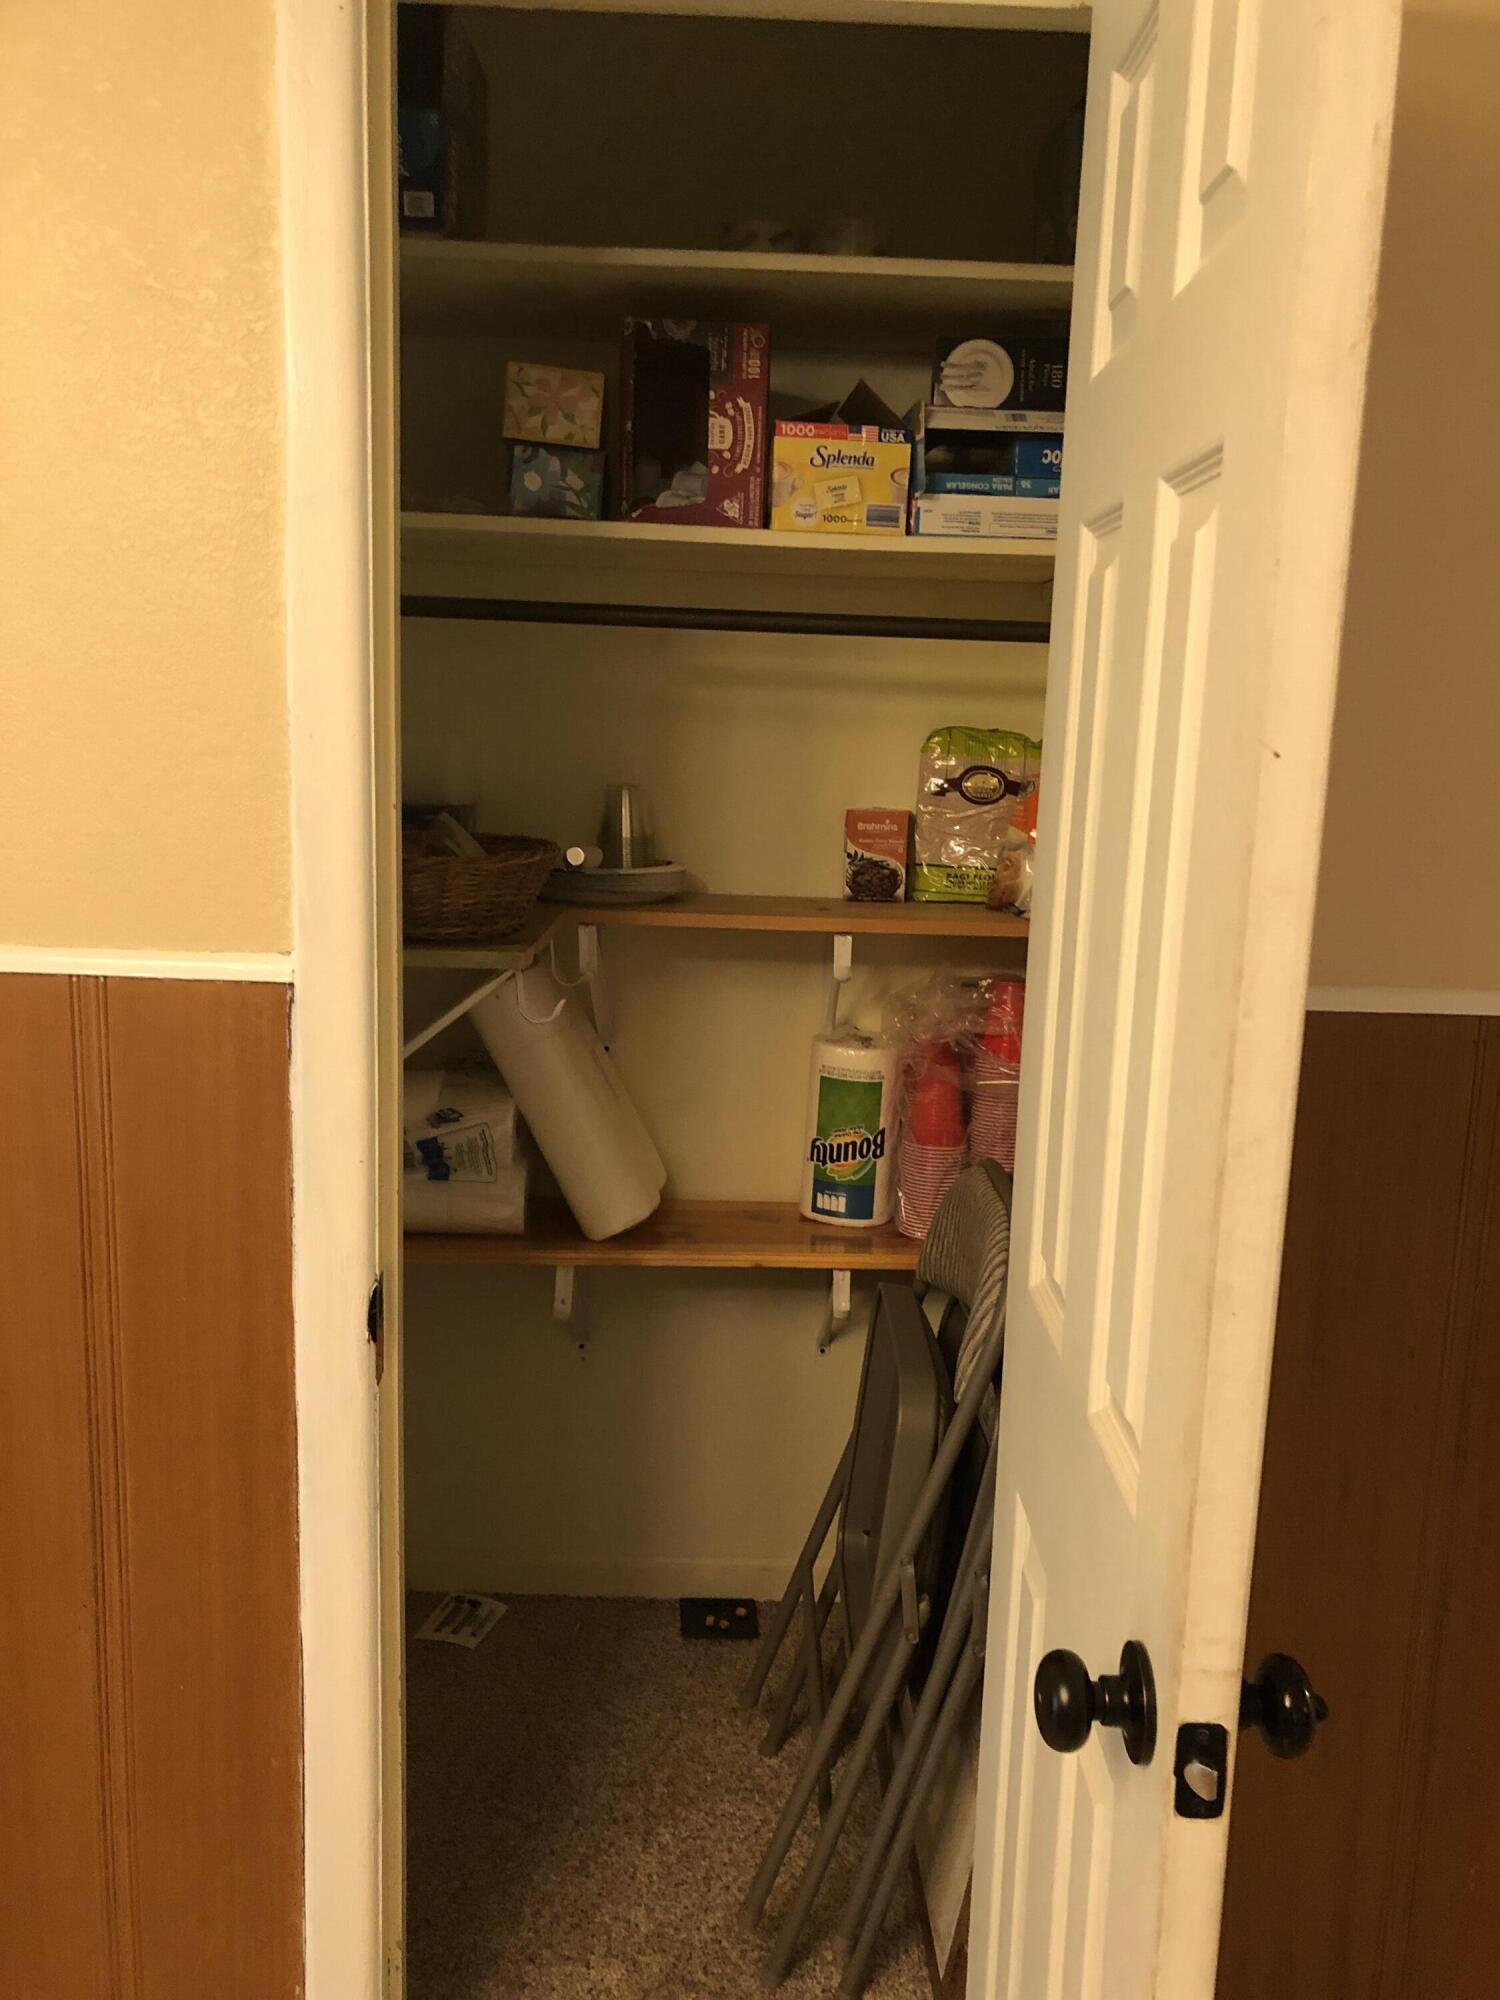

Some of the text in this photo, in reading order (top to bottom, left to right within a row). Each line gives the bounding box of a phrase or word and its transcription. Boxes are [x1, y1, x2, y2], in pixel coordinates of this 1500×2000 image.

[780, 423, 816, 437] 1000
[880, 431, 906, 443] USA
[809, 444, 876, 470] Splenda
[823, 513, 848, 524] 1000
[857, 819, 898, 832] Brahmins
[809, 1127, 886, 1170] Bounty
